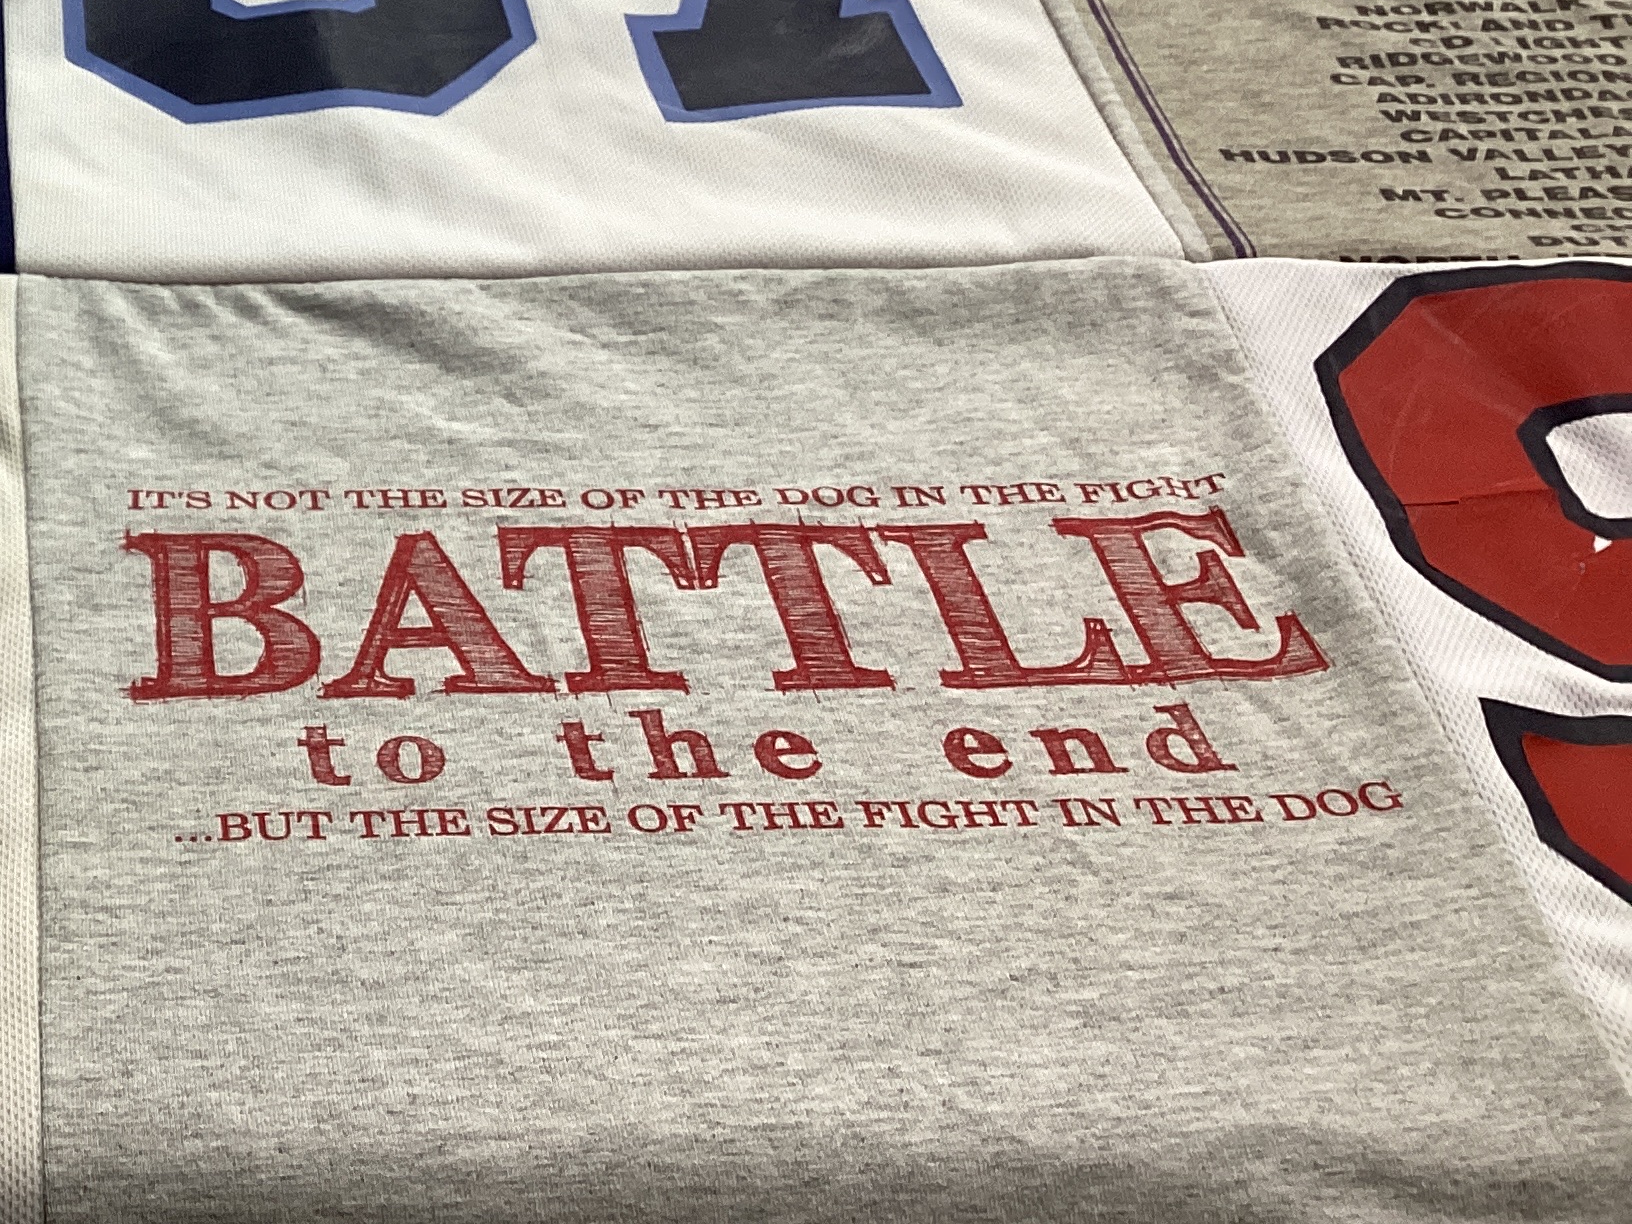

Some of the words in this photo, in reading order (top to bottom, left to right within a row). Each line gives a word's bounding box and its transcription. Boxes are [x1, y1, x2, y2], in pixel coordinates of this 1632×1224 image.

[1335, 50, 1628, 71] RIDGEWOOD
[1218, 147, 1434, 165] HUDSON
[1377, 187, 1466, 203] MT.
[127, 488, 213, 511] IT'S
[225, 488, 330, 511] NOT
[344, 487, 449, 510] THE
[461, 486, 567, 510] SIZE
[580, 487, 646, 511] OF
[658, 486, 763, 510] THE
[773, 484, 881, 509] DOG
[895, 484, 946, 508] IN
[959, 482, 1062, 506] THE
[1072, 472, 1227, 506] FIGHT
[120, 506, 1330, 701] BATTLE
[298, 722, 447, 786] to
[556, 708, 824, 784] the
[940, 703, 1239, 780] end
[348, 808, 470, 839] THE
[486, 805, 613, 836] SIZE
[627, 803, 705, 834] OF
[719, 800, 844, 832] THE
[860, 798, 1040, 830] FIGHT
[1050, 796, 1123, 828] IN
[1132, 793, 1266, 825] THE
[1272, 779, 1406, 822] DOG
